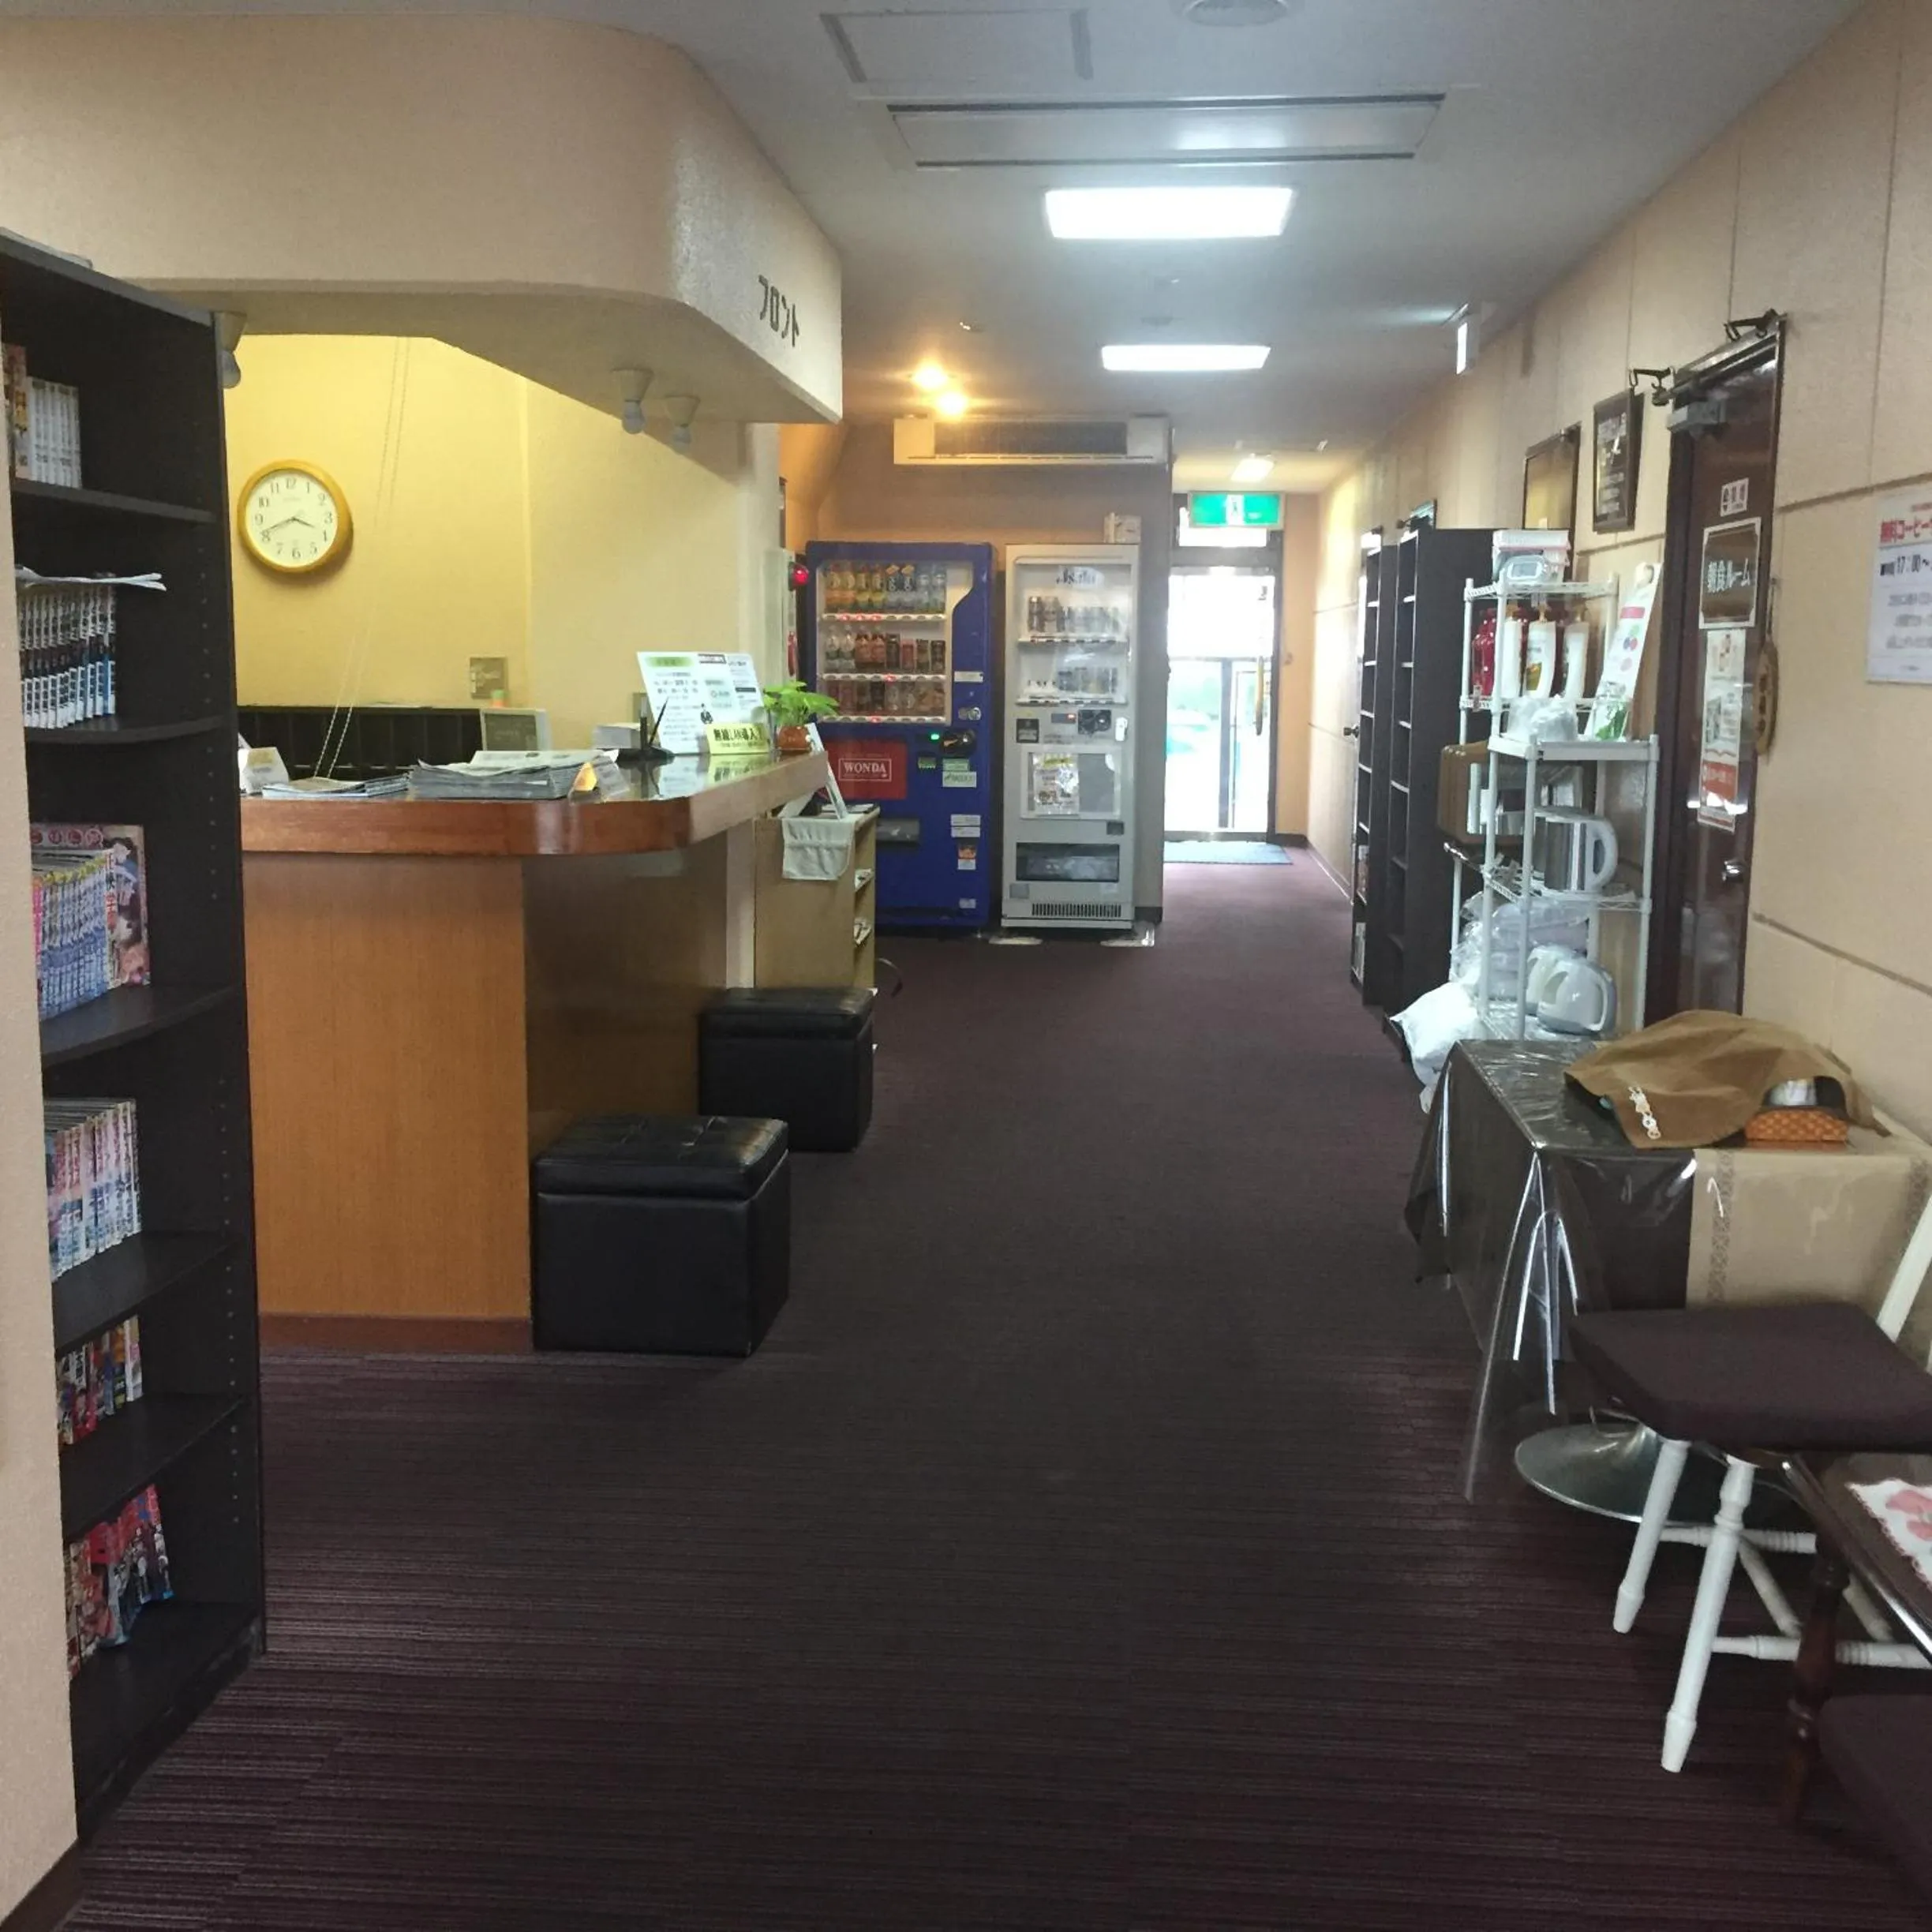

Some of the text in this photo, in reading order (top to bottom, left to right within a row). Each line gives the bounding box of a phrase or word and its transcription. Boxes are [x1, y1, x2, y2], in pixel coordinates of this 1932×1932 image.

[758, 275, 799, 347] フロント
[844, 762, 886, 773] WONDA
